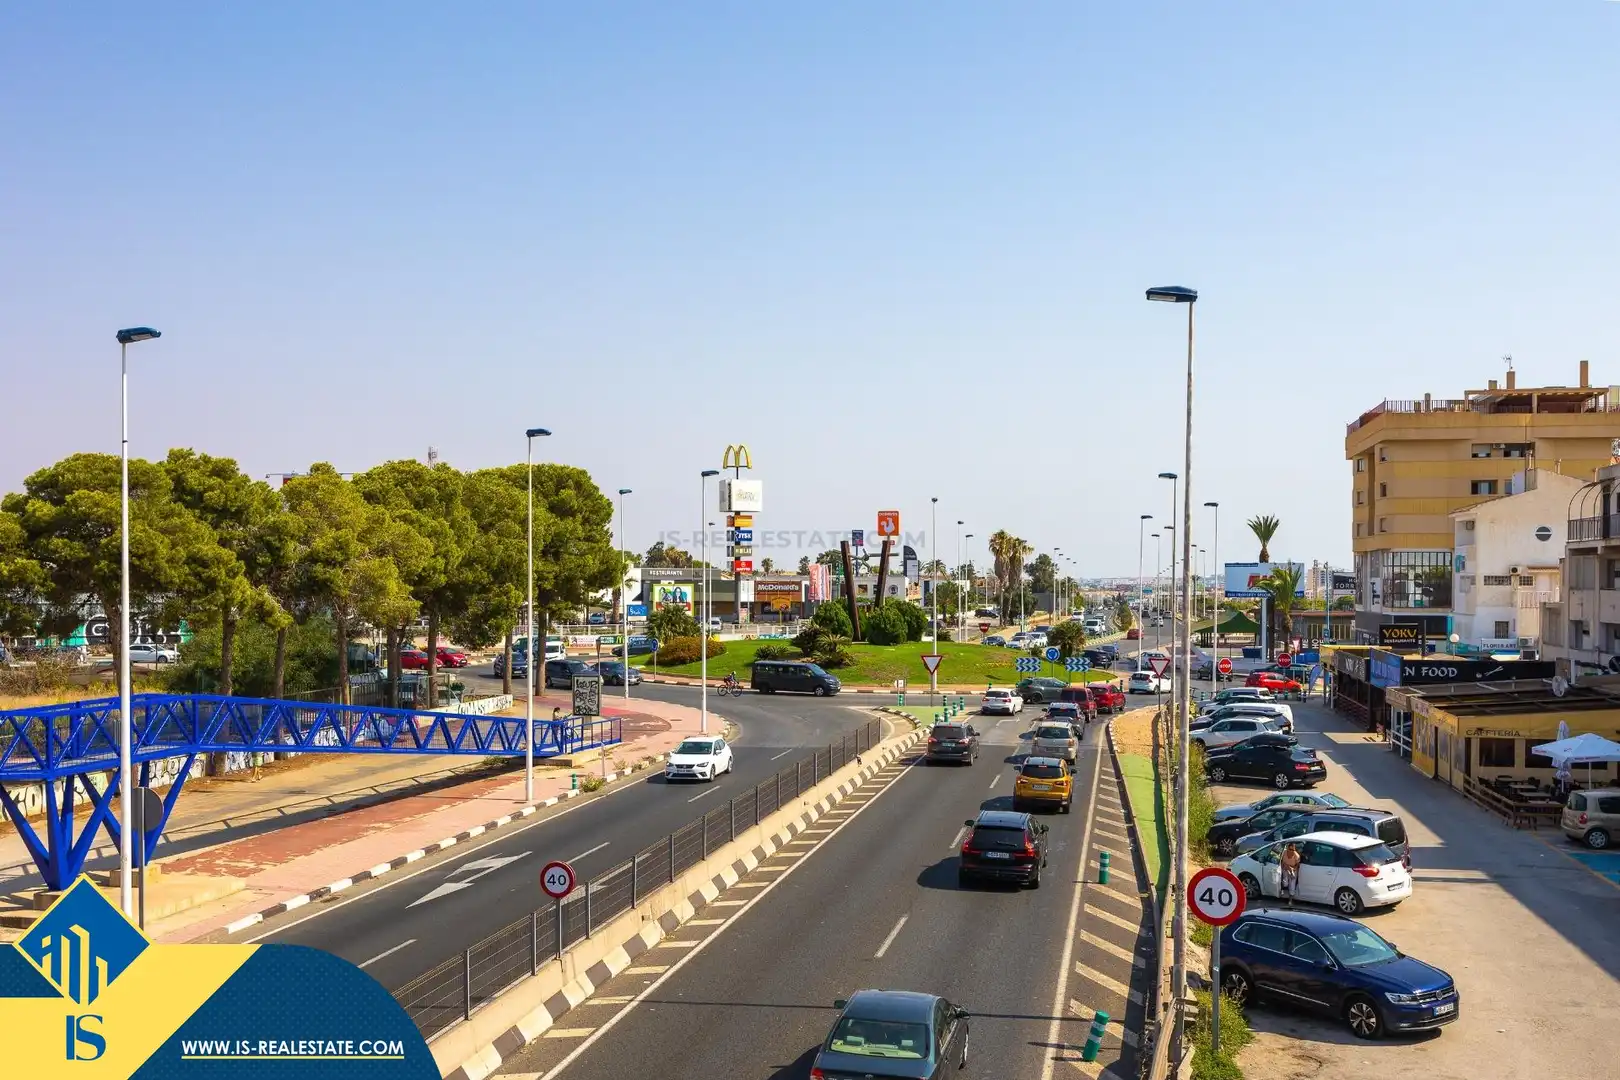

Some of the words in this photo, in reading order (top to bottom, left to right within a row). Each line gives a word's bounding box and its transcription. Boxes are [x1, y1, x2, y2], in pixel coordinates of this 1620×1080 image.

[1382, 628, 1417, 638] YOKU
[1403, 666, 1415, 676] N
[1421, 666, 1458, 677] FOOD
[546, 873, 567, 886] 40
[1199, 887, 1233, 907] 40
